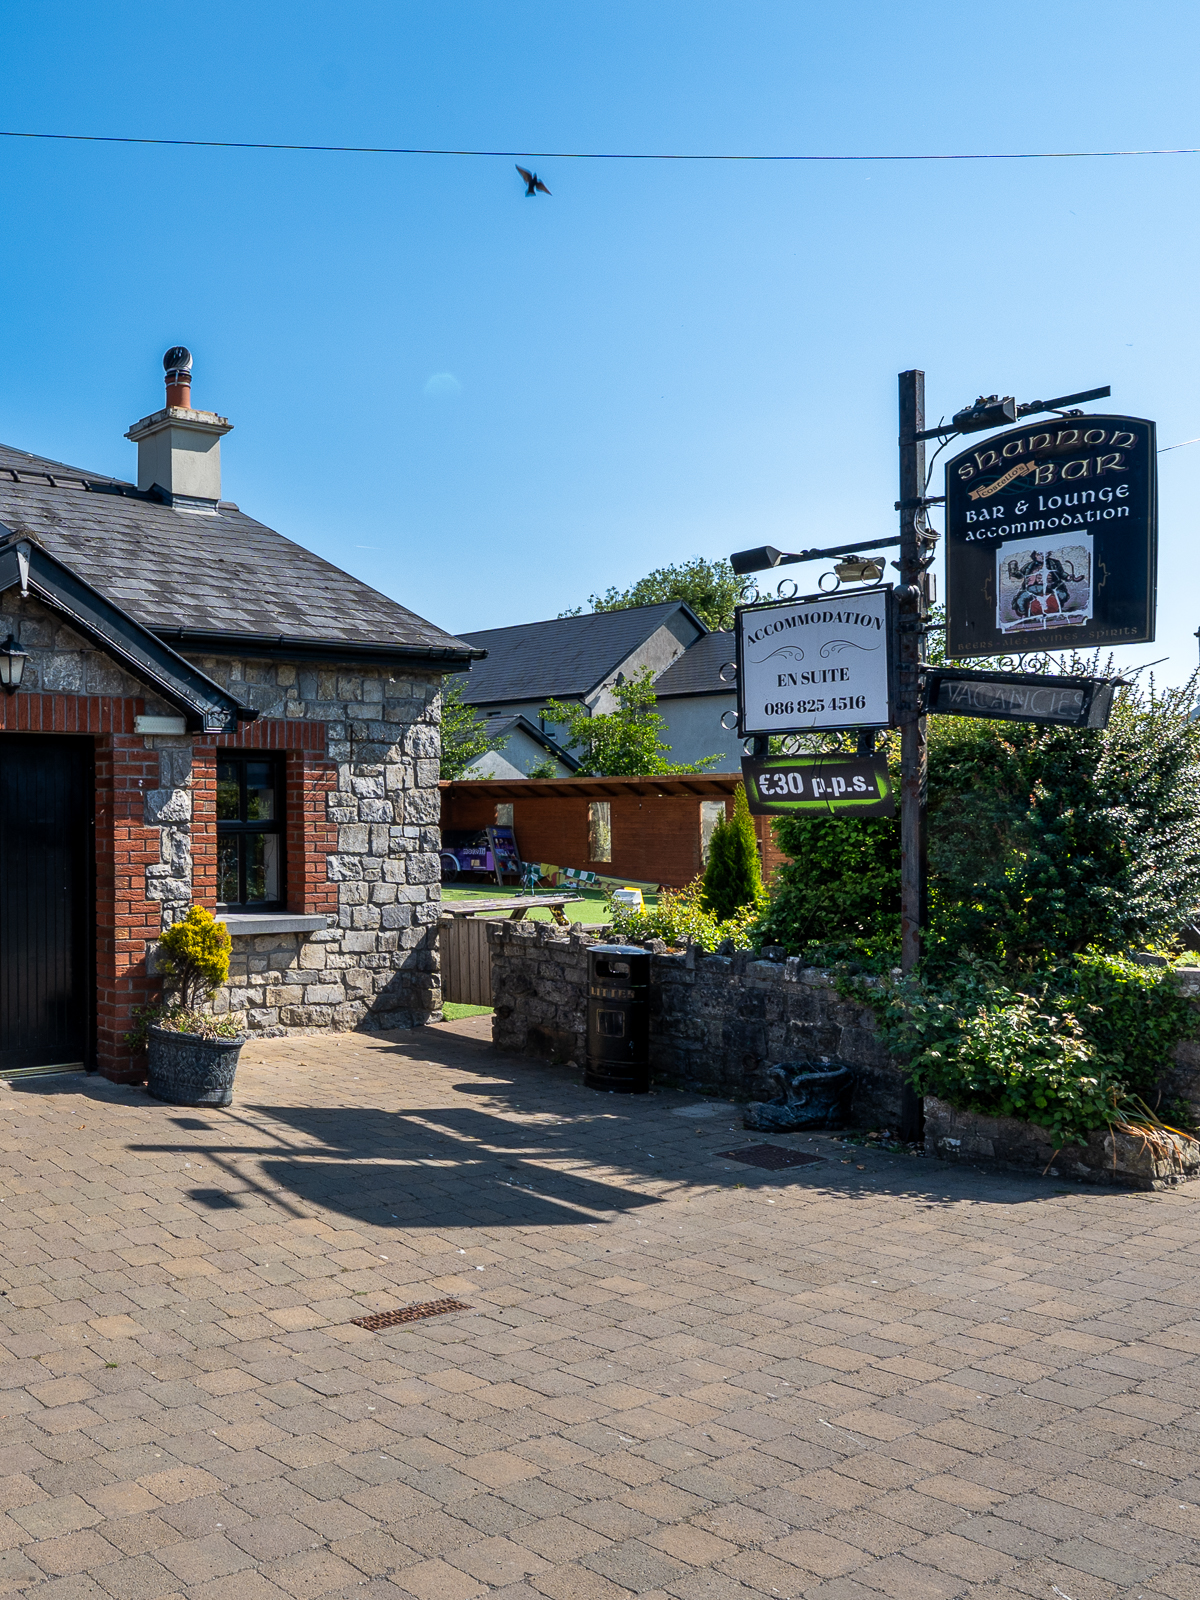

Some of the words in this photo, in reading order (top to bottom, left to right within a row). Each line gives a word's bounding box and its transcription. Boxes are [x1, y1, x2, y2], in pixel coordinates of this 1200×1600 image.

[1015, 500, 1030, 515] &
[748, 611, 884, 647] ACCOMMODATION
[777, 673, 798, 688] EN
[801, 667, 850, 685] SUITE
[764, 702, 794, 716] 086
[797, 699, 825, 714] 825
[828, 695, 866, 711] 4516
[948, 683, 1084, 716] VACANCIES
[759, 772, 804, 795] €30
[591, 986, 635, 999] LITTER
